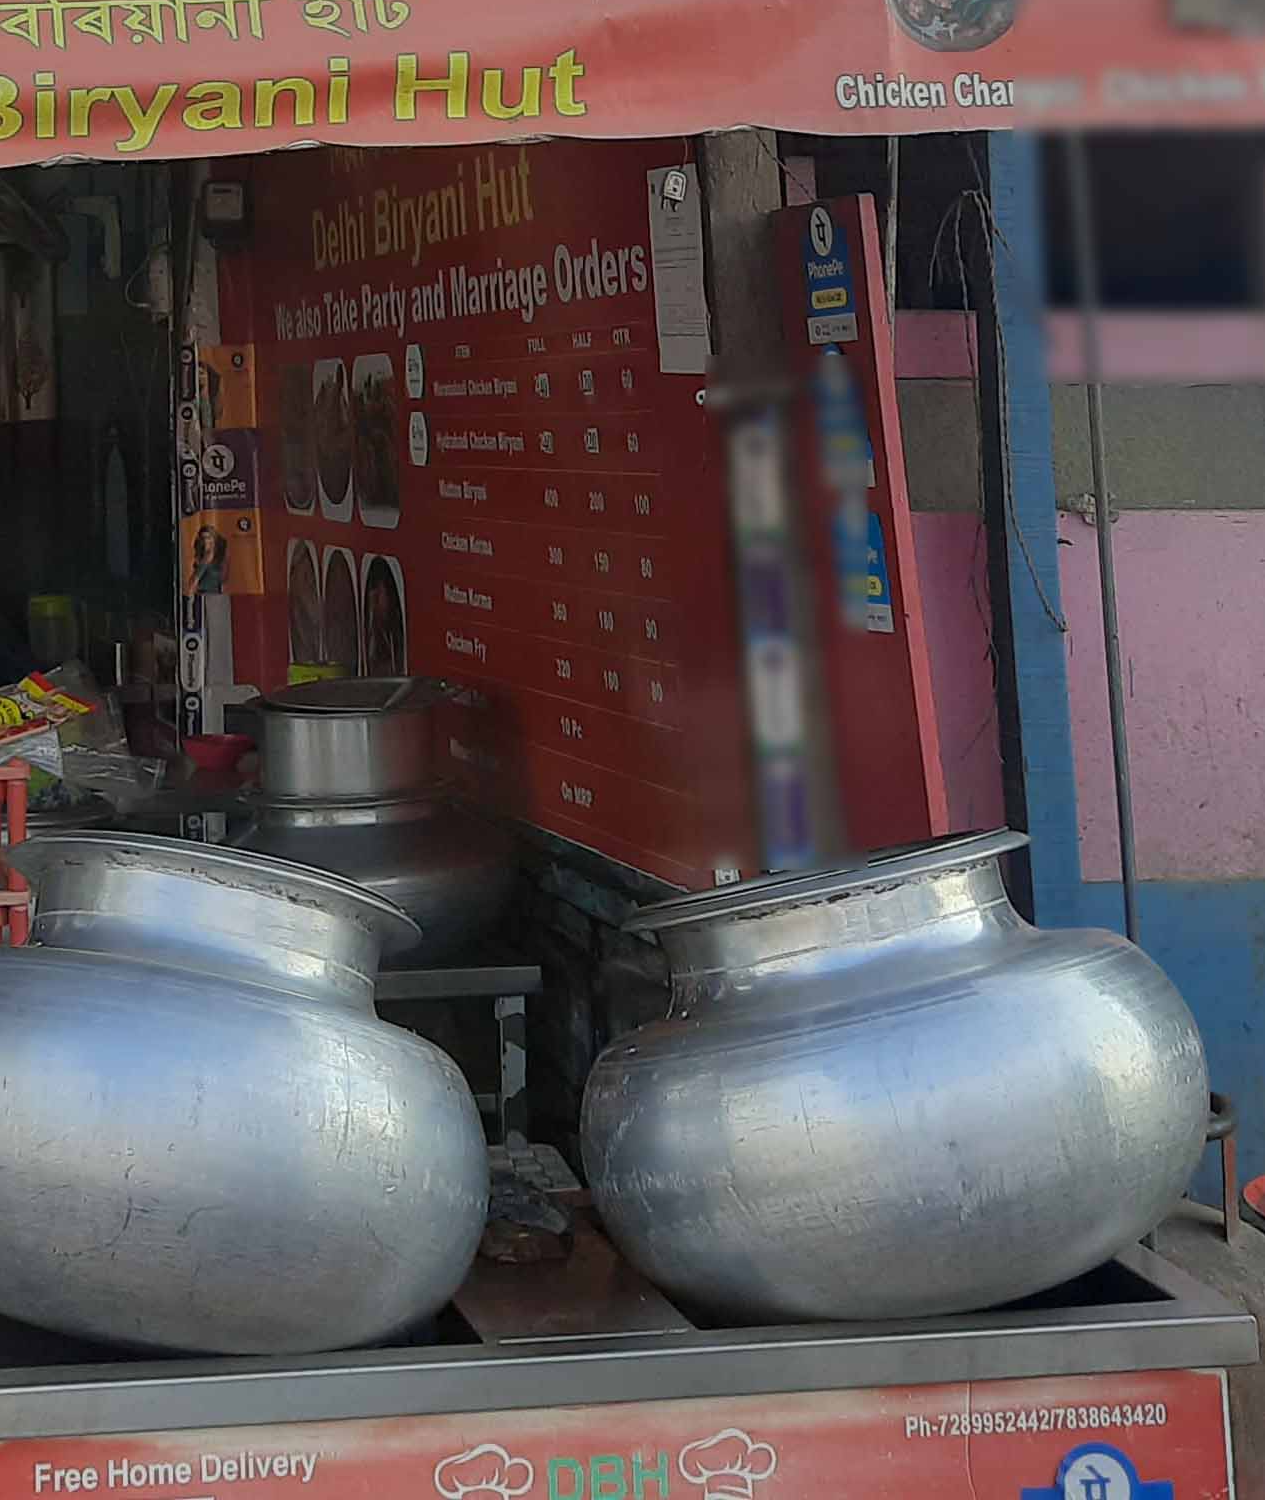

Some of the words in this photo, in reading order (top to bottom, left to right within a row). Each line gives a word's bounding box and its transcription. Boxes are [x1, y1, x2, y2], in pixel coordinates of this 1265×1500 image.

[394, 47, 587, 123] Hut
[836, 75, 947, 109] Chicken
[311, 198, 367, 273] Delhi
[374, 160, 467, 265] Biryani
[475, 148, 534, 232] Hut
[807, 259, 844, 280] PhonePe
[275, 302, 293, 341] We
[294, 299, 321, 340] also
[323, 293, 358, 335] Take
[362, 284, 407, 338] Party
[410, 273, 446, 323] and
[450, 256, 547, 323] Marriage
[553, 237, 649, 304] Orders
[526, 337, 546, 354] FULL
[572, 331, 592, 349] HALF
[612, 328, 632, 347] QTR
[634, 495, 650, 516] 100
[593, 553, 610, 573] 150
[904, 1402, 1168, 1438] Ph-7289952442/7838643420
[34, 1461, 103, 1494] Free
[108, 1454, 193, 1489] Home
[200, 1450, 317, 1487] Delivery
[548, 1451, 670, 1500] DBH
